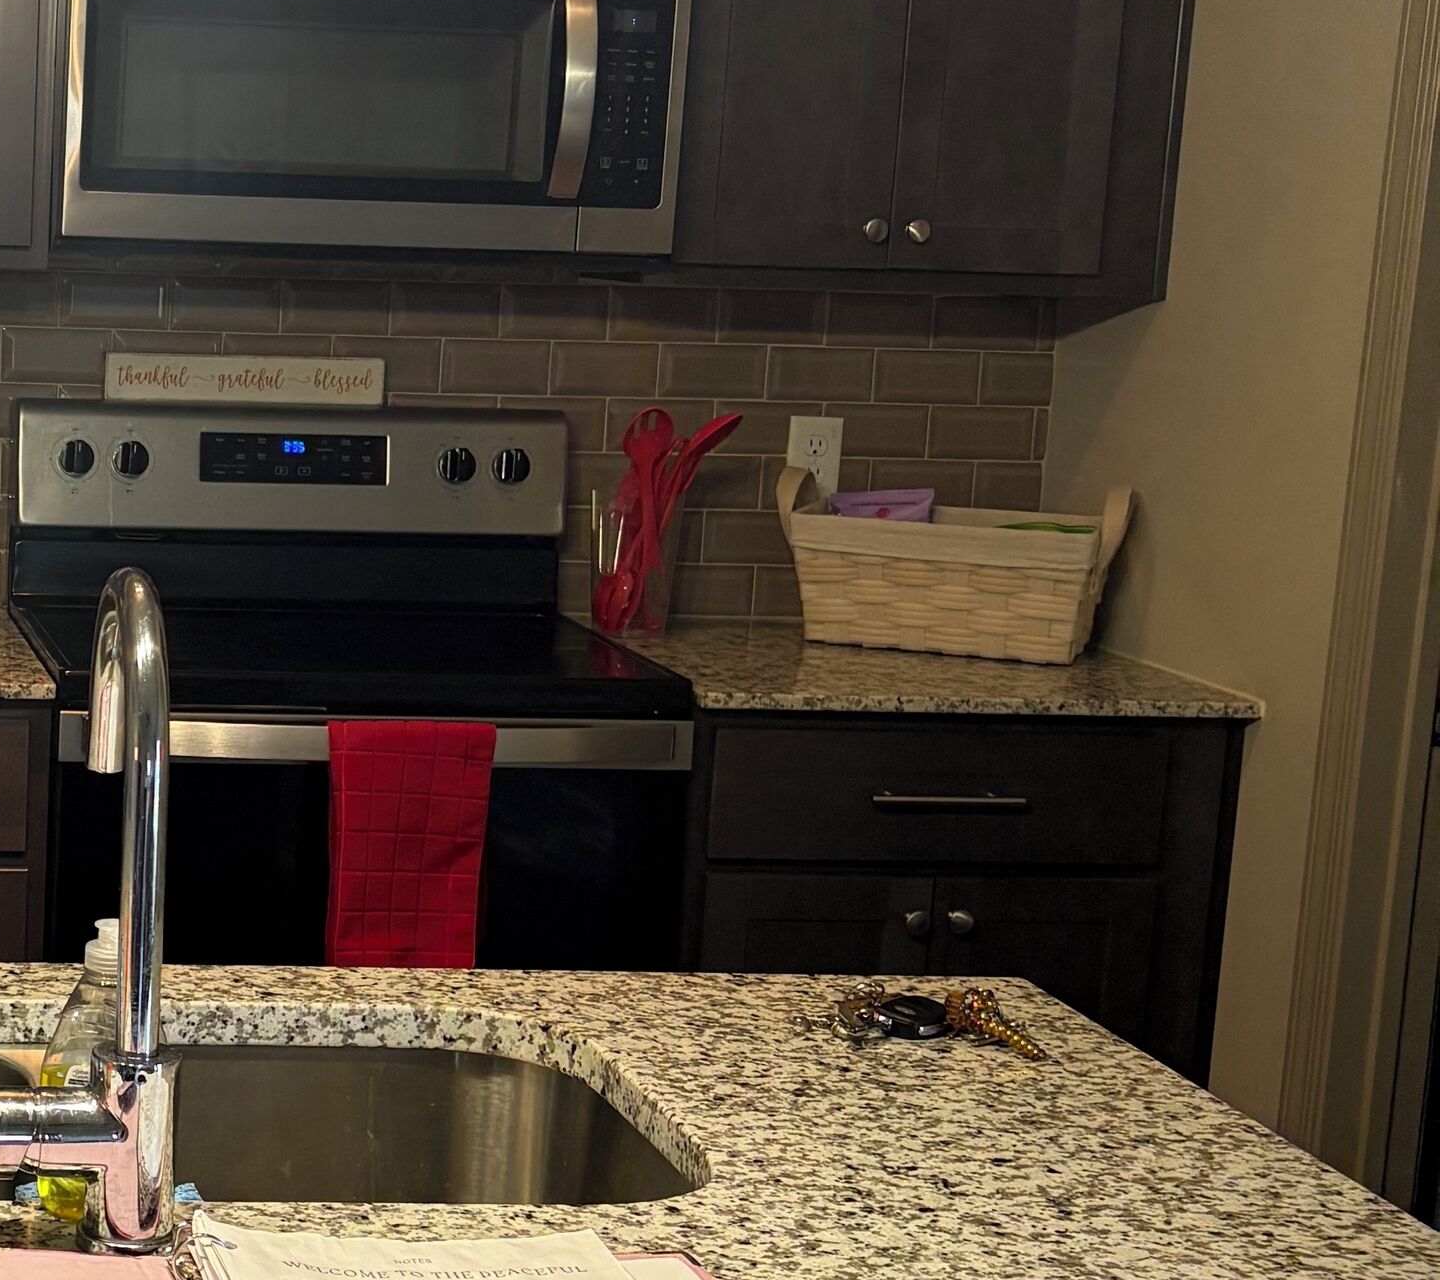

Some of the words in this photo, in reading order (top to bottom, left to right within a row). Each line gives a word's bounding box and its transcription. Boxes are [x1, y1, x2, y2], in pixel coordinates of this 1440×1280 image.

[118, 365, 190, 389] thankful
[218, 368, 284, 392] grateful
[314, 368, 374, 394] blessed
[282, 1261, 390, 1279] WELCOME
[394, 1270, 424, 1278] TO
[430, 1271, 474, 1279] THE
[479, 1266, 588, 1279] PEACEFUL
